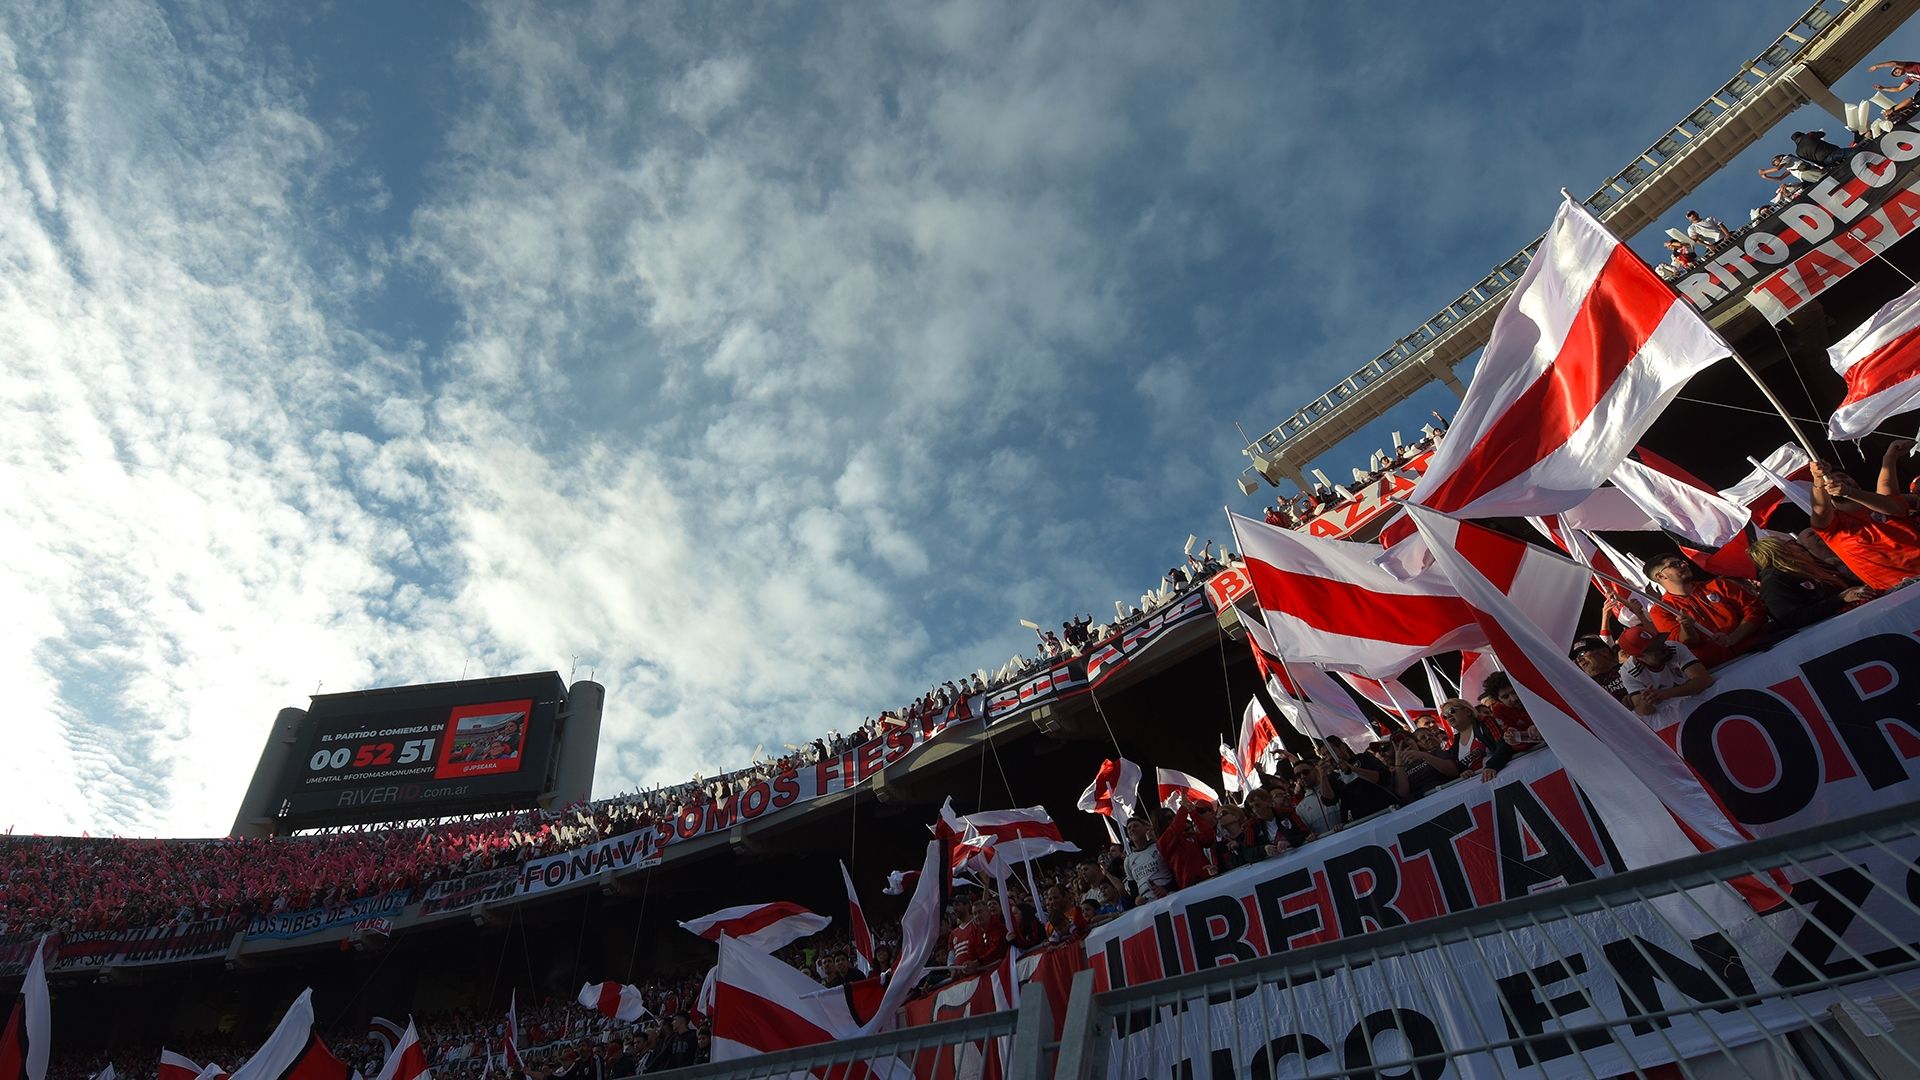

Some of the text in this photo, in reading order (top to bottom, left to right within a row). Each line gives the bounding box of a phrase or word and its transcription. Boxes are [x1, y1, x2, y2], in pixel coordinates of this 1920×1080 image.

[1778, 175, 1870, 246] DE
[310, 738, 435, 770] 00 52 51
[321, 723, 445, 742] EL PARTIDO COMIENZA EN
[654, 692, 974, 849] SOMOS FIESTA
[522, 831, 652, 893] FONAVI
[1105, 632, 1920, 1040] LIBERTAOR
[247, 894, 394, 936] LOS PIBES DE SAVIO
